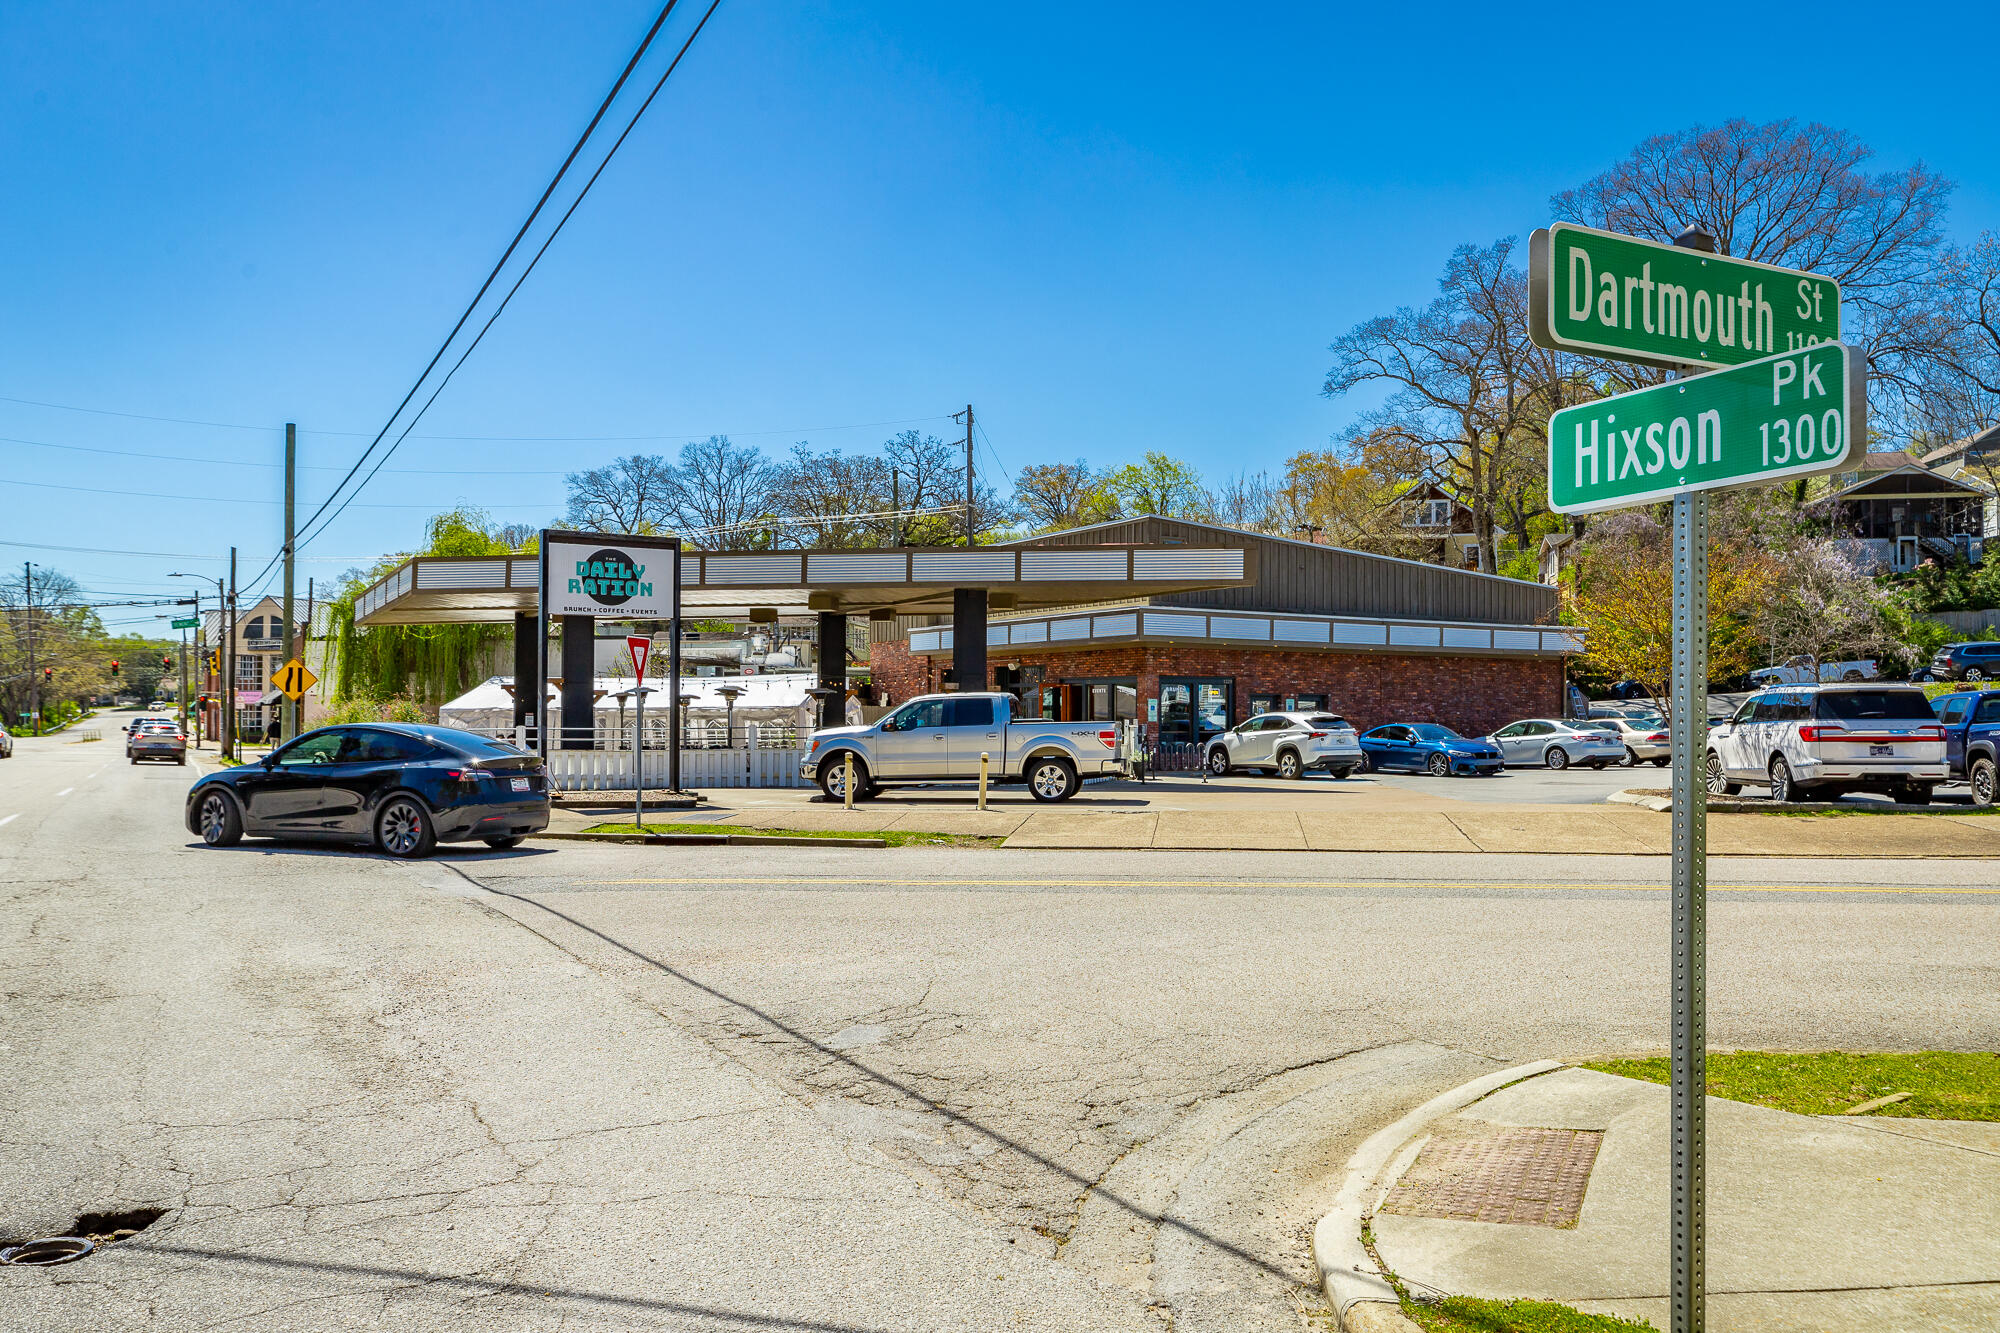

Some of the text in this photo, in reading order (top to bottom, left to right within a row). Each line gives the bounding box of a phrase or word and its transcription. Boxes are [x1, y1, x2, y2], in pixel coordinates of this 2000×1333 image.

[1568, 246, 1823, 353] Dartmouth St
[1575, 355, 1827, 488] Hixson Pk
[1759, 408, 1842, 467] 1300
[568, 578, 653, 597] RATION
[576, 561, 646, 580] DAILY
